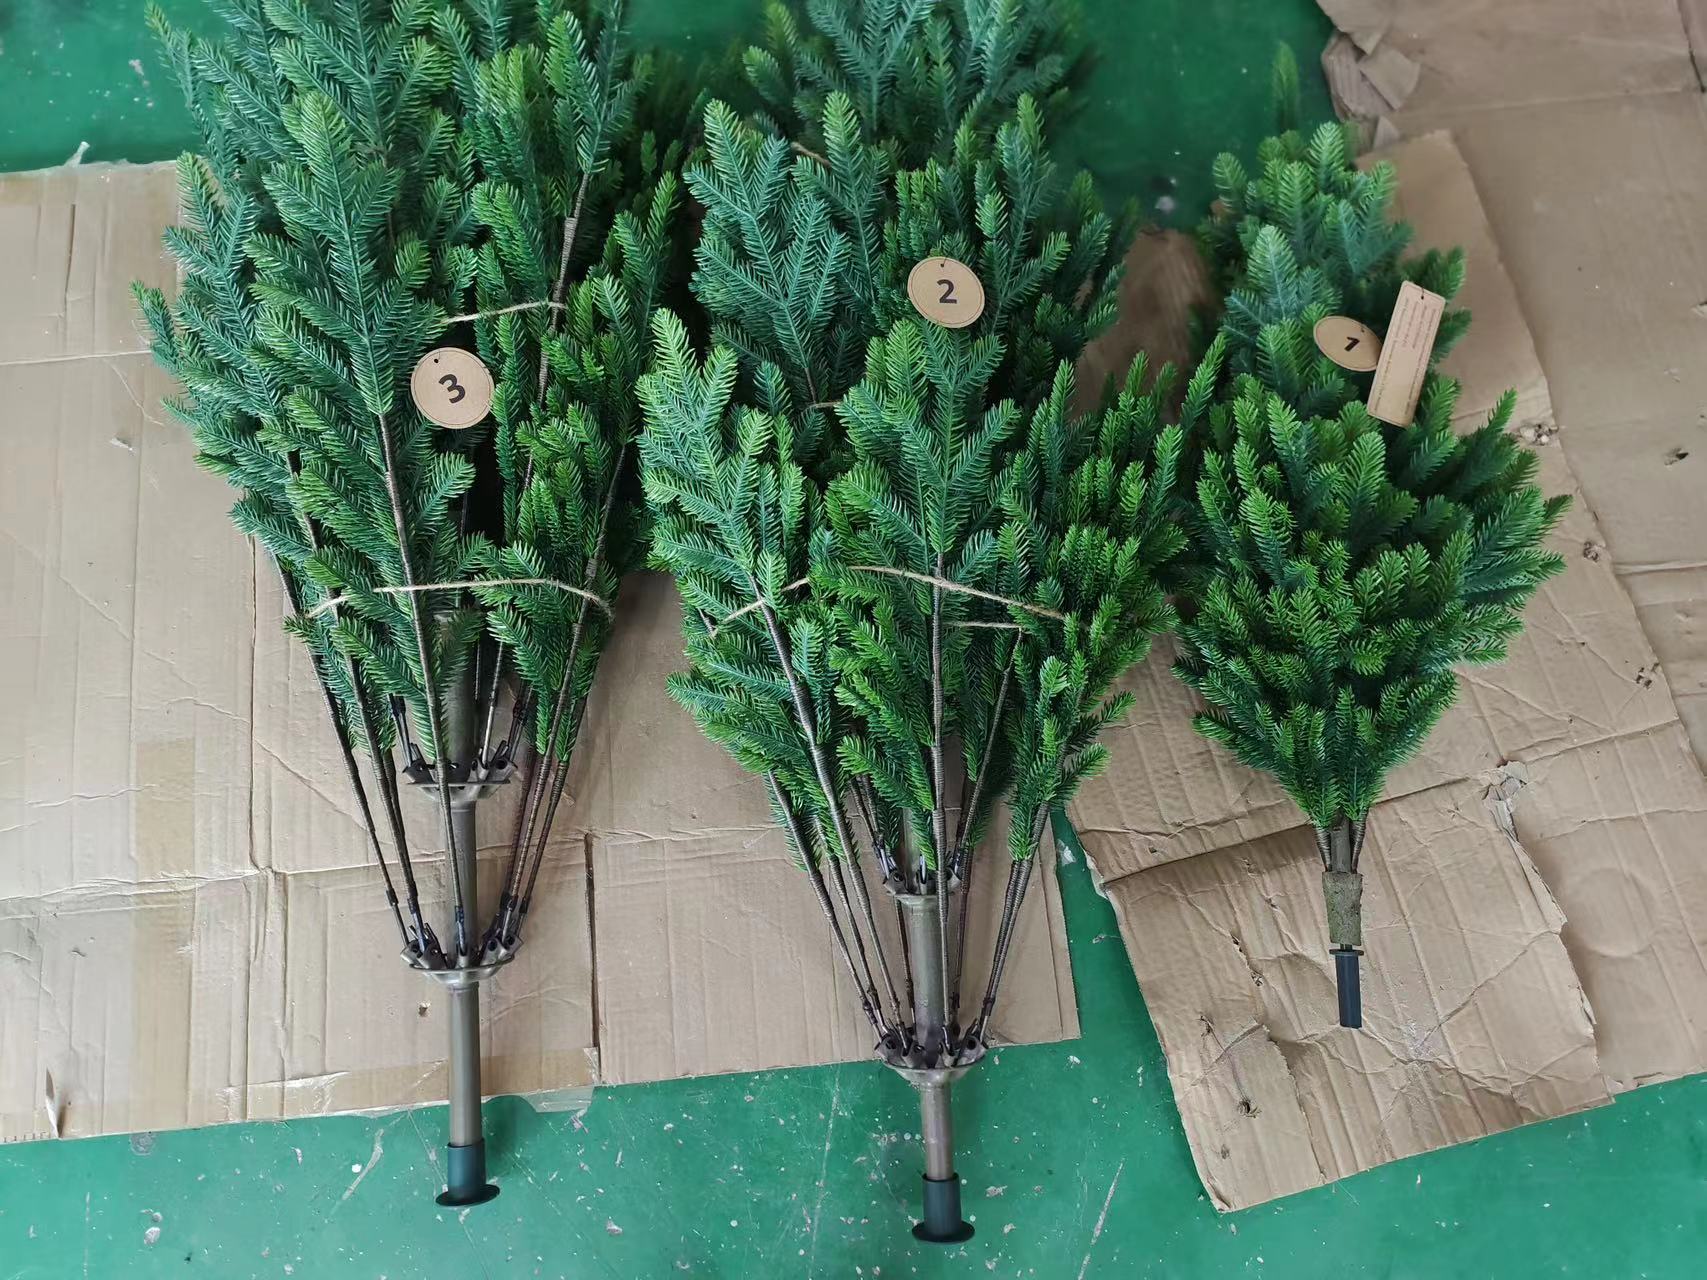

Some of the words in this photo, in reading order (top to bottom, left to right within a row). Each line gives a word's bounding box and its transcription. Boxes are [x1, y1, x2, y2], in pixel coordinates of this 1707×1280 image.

[936, 278, 957, 304] 2
[1344, 336, 1360, 352] 1
[438, 373, 466, 404] 3
